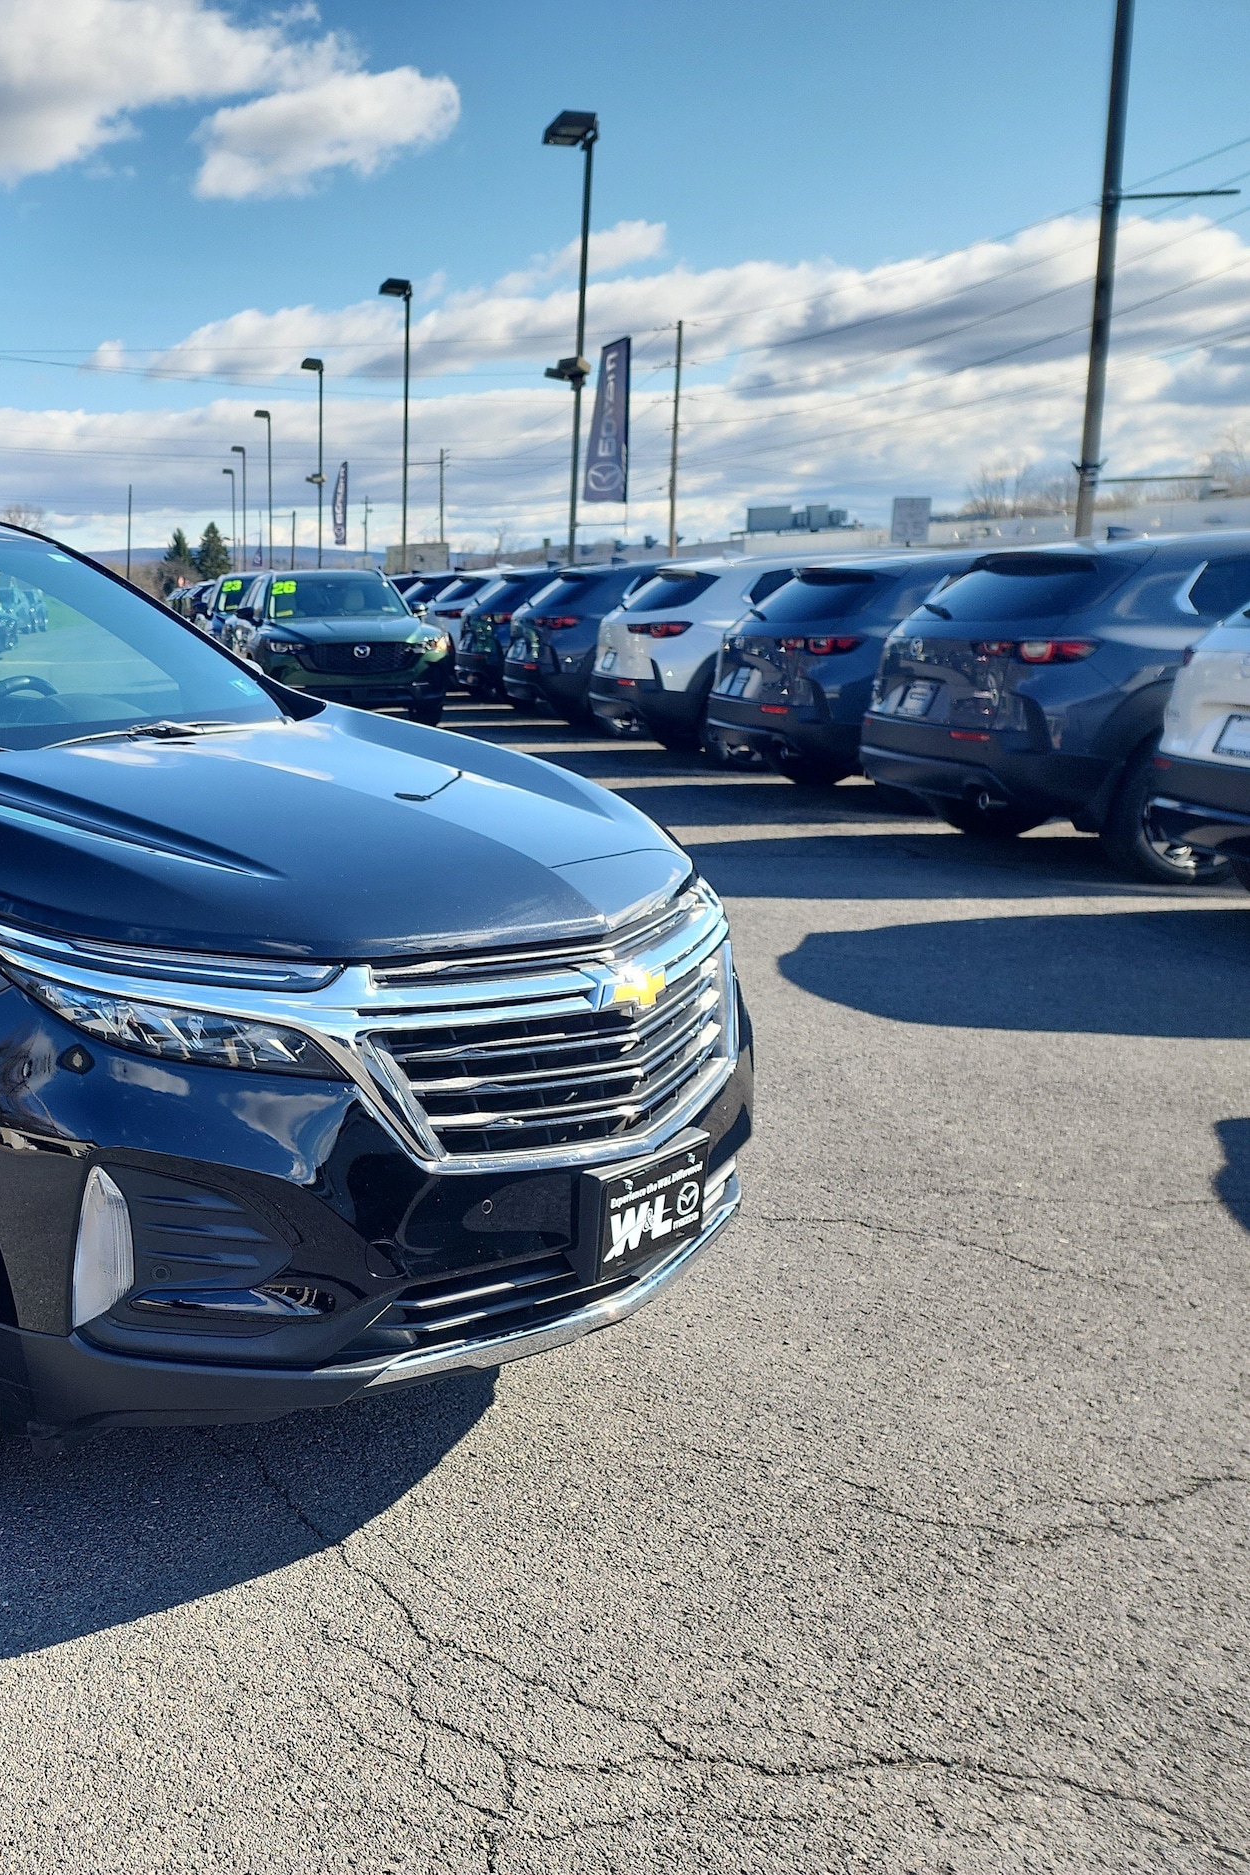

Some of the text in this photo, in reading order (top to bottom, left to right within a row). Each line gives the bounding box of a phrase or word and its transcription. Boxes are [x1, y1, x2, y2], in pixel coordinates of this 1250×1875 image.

[222, 580, 242, 592] 23
[272, 581, 296, 595] 26
[603, 1194, 672, 1263] W&L
